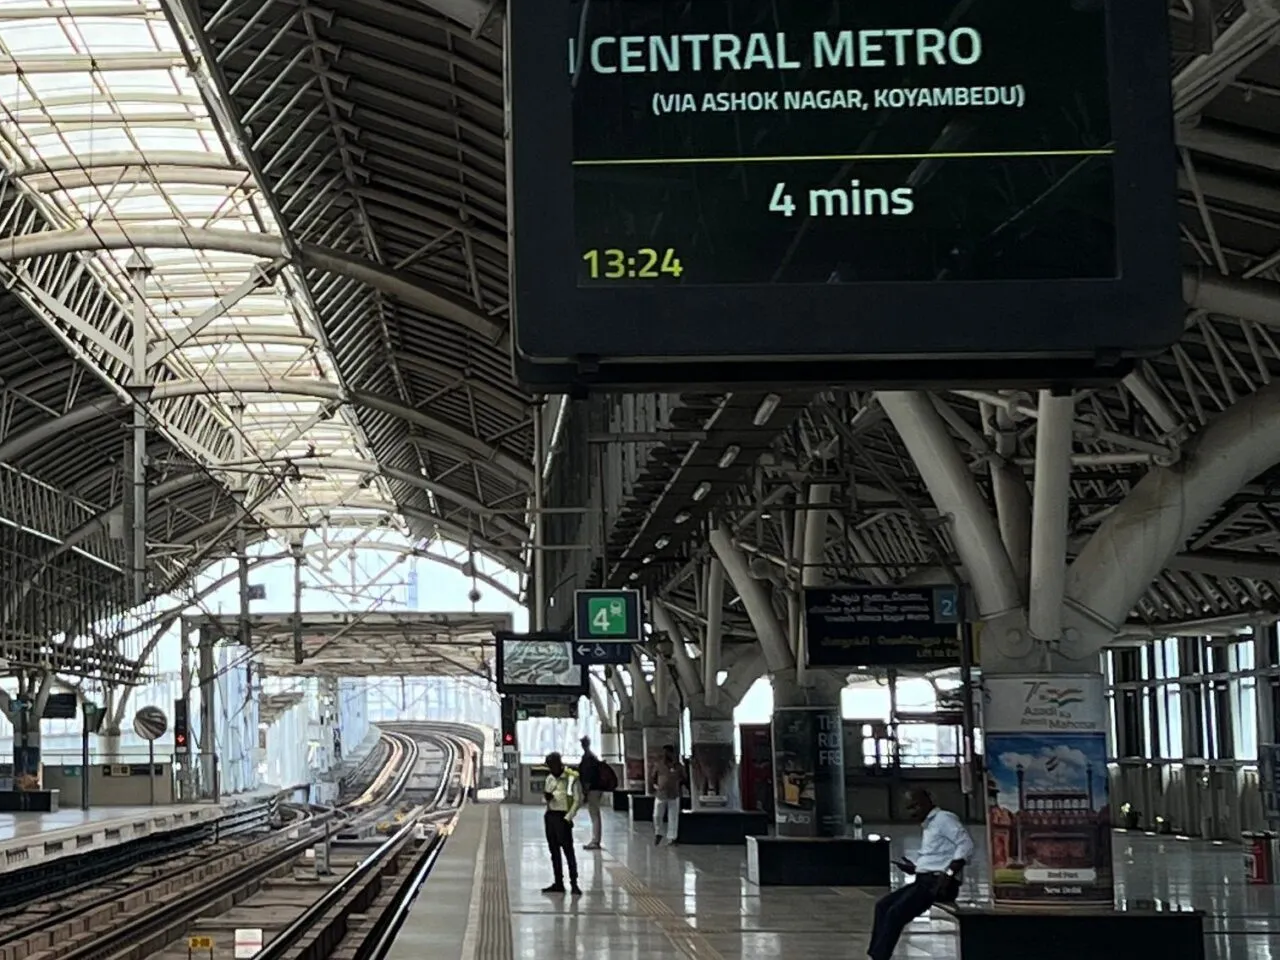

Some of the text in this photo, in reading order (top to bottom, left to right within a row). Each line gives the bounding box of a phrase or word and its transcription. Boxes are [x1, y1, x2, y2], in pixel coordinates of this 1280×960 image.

[591, 32, 801, 74] CENTRAL
[813, 27, 982, 69] METRO
[652, 85, 1025, 116] (VIA ASHOK NAGAR, KOYAMBEDU)
[768, 179, 914, 217] 4 mins
[583, 248, 683, 278] 13:24
[593, 607, 611, 632] 4
[940, 599, 953, 617] 2
